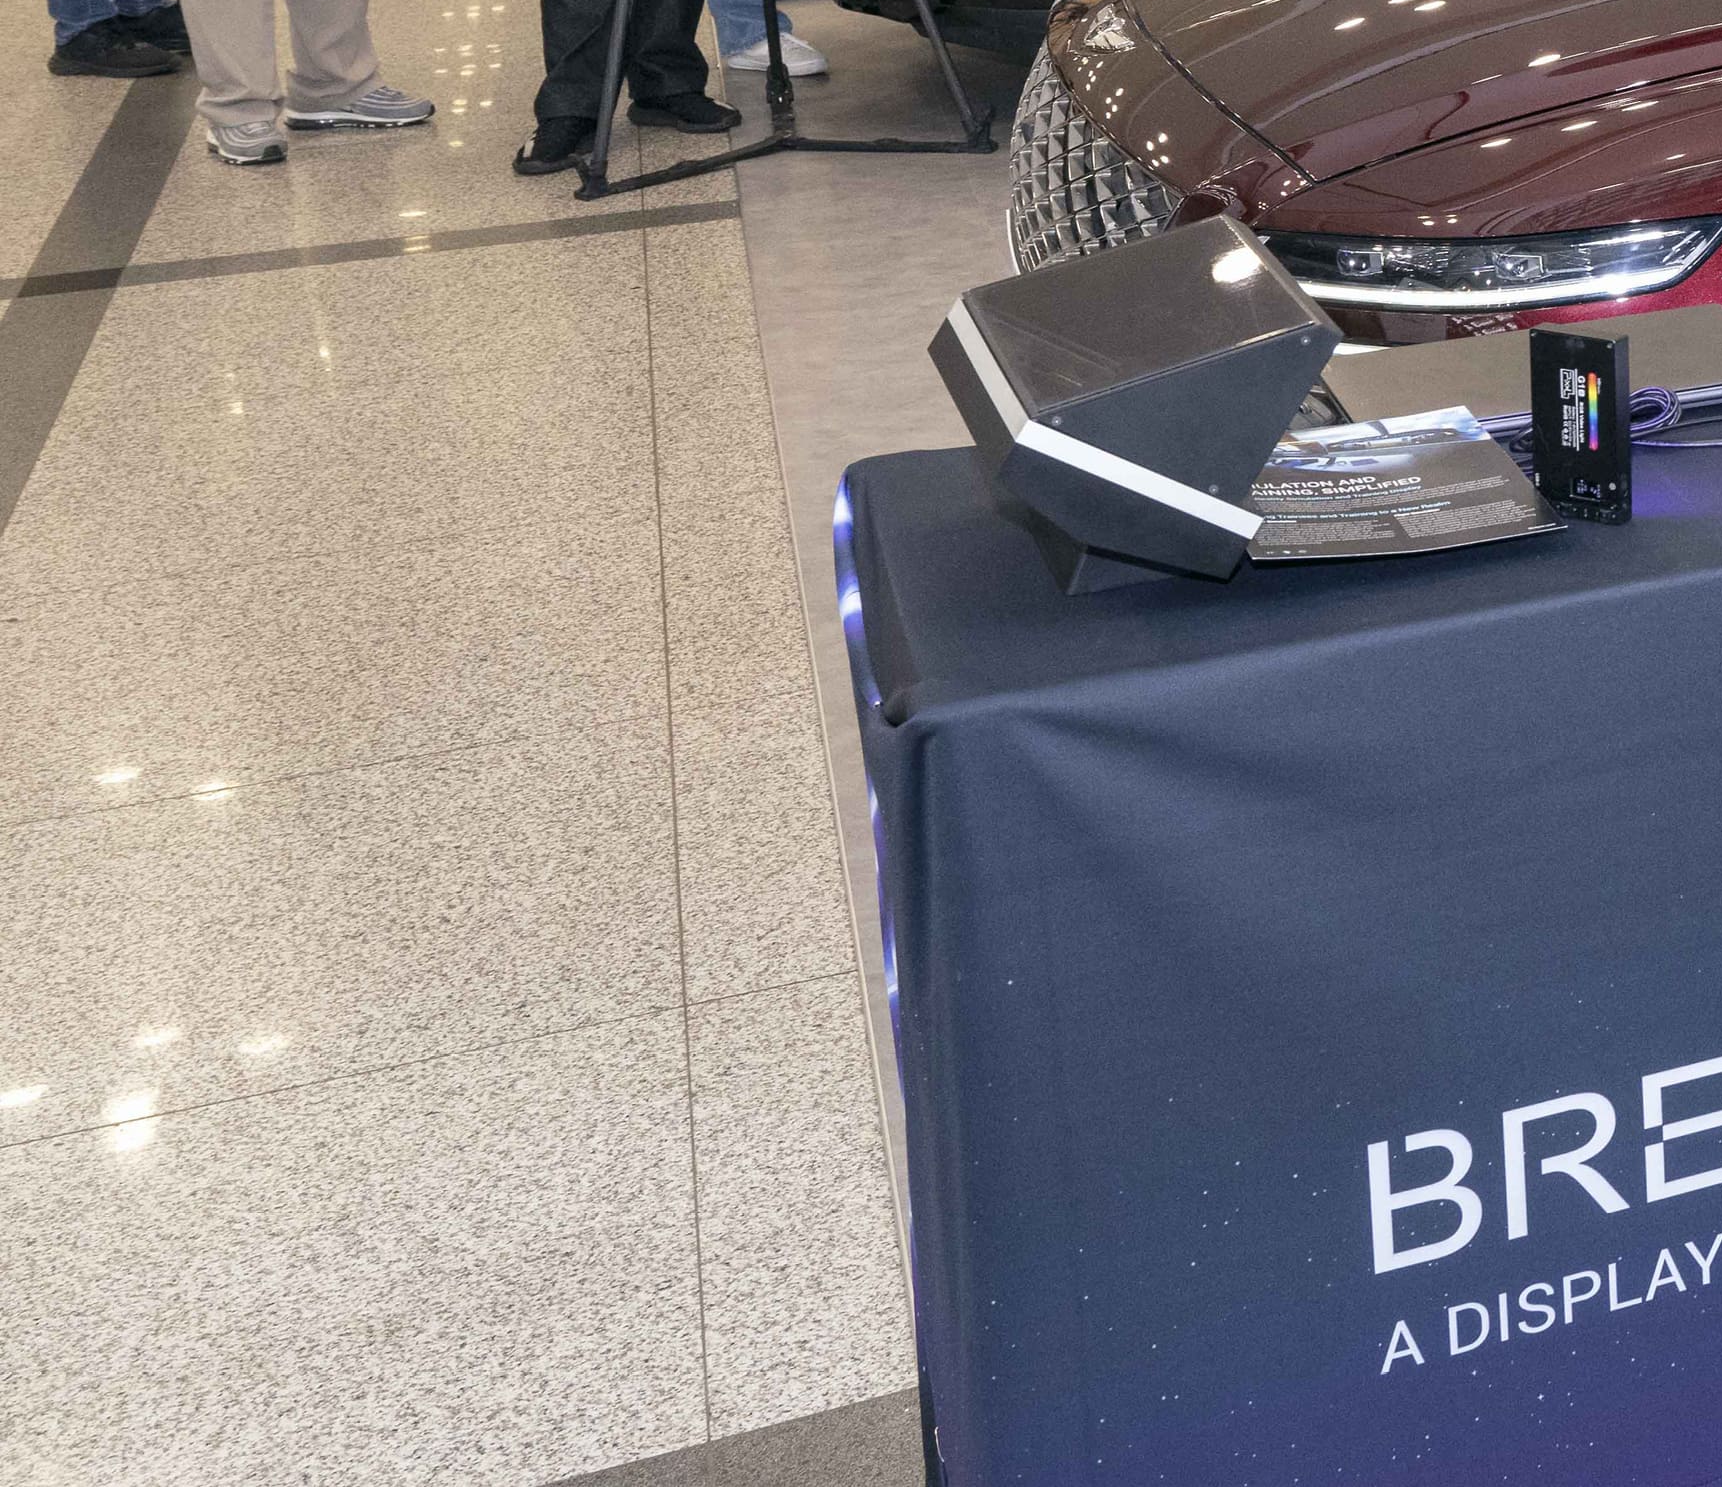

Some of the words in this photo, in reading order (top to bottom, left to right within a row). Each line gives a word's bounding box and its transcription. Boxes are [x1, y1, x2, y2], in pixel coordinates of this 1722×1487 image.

[1322, 477, 1422, 495] SIMPLIFIED
[1339, 476, 1376, 486] AND
[1380, 1320, 1424, 1375] A
